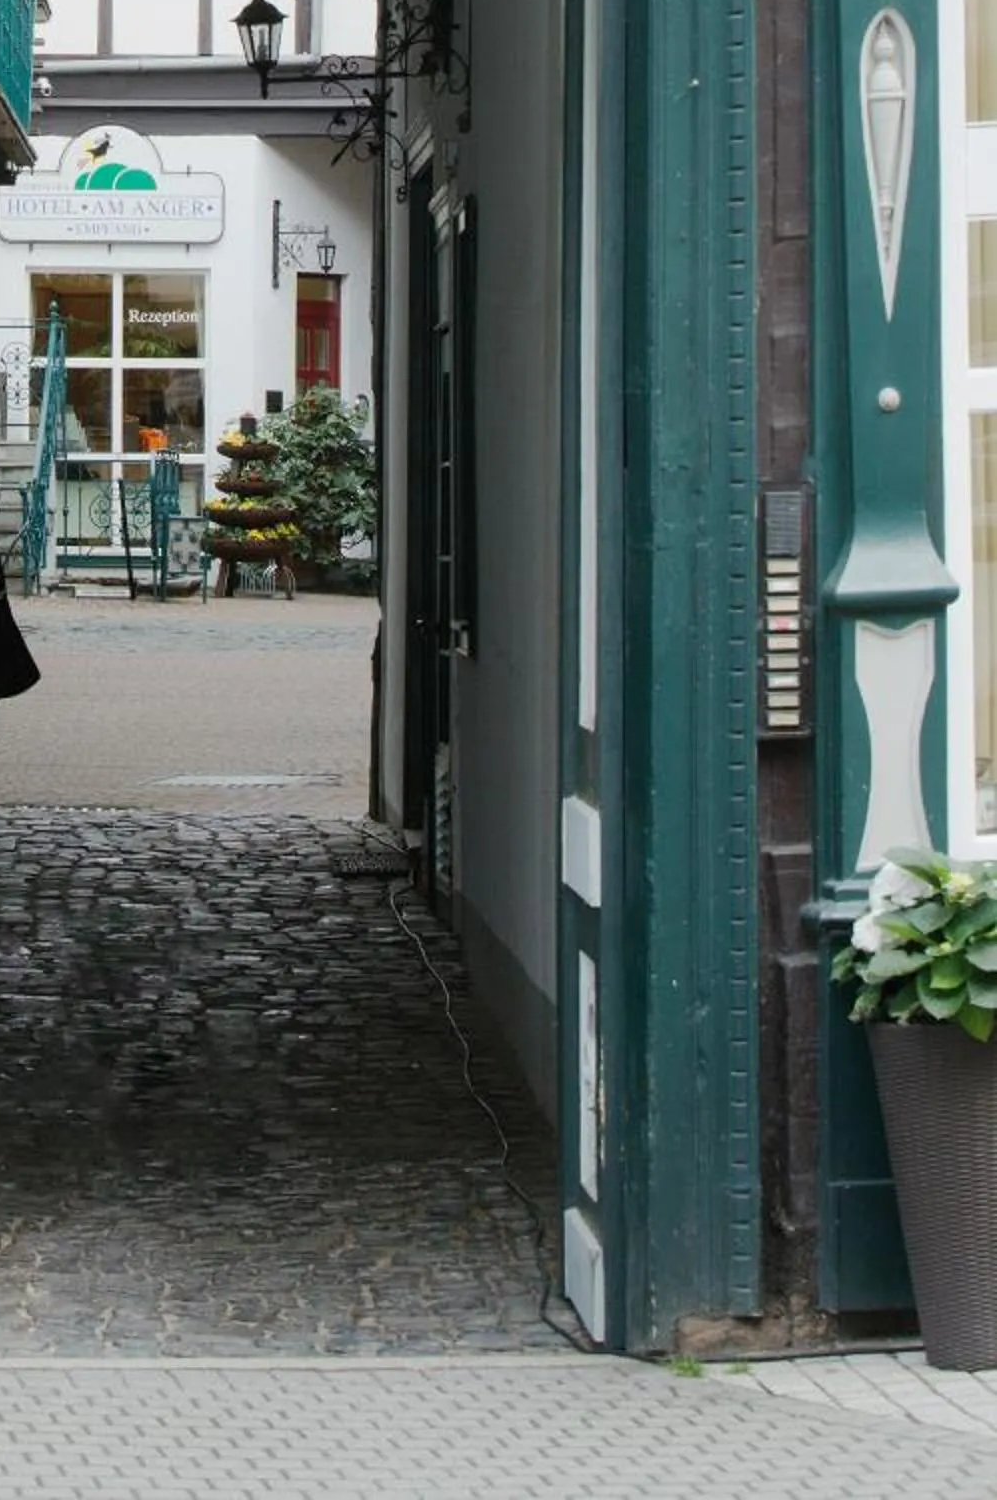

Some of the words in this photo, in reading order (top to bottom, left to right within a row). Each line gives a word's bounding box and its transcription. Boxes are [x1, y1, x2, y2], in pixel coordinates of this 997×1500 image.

[7, 198, 80, 216] HOTEL
[92, 199, 124, 216] AM
[133, 199, 204, 217] ANGER
[128, 308, 199, 327] Rezeption
